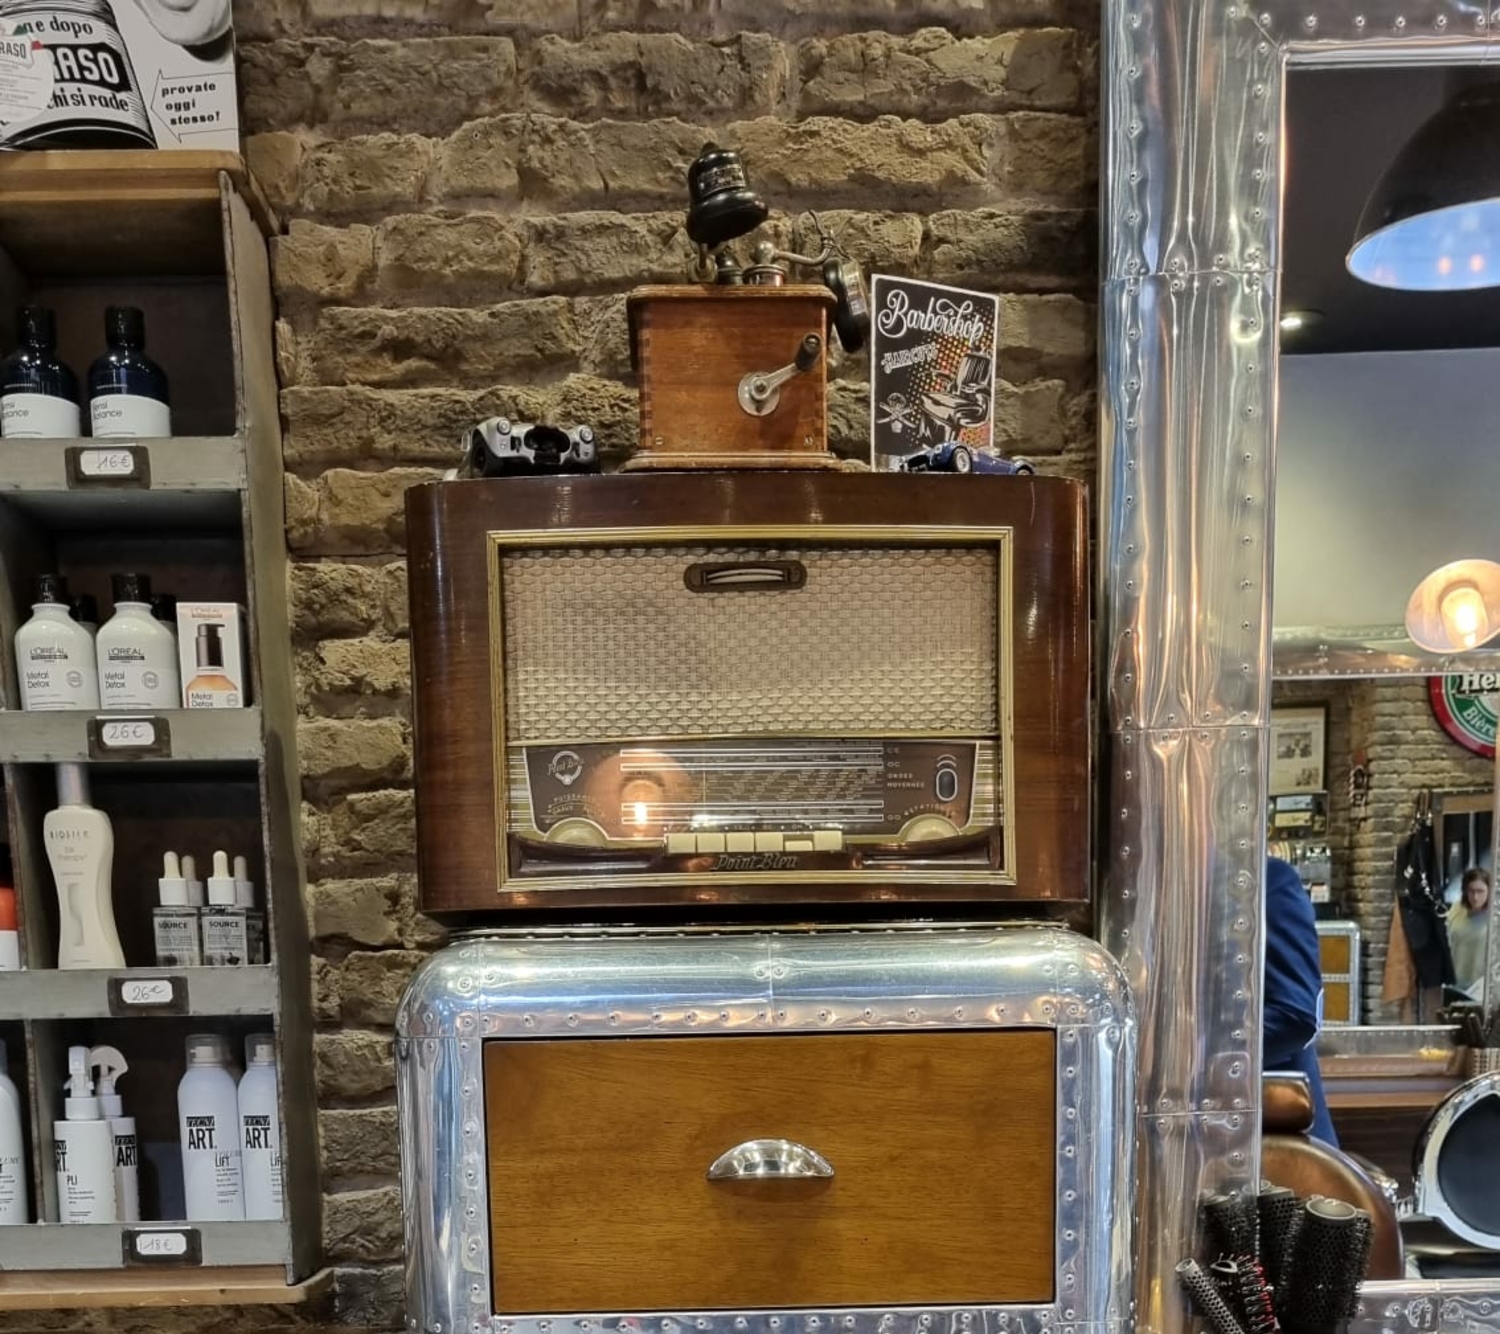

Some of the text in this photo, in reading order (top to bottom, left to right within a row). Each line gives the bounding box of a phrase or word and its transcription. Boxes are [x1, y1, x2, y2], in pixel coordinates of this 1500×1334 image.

[50, 15, 94, 39] dopo
[161, 81, 217, 98] provate
[88, 93, 130, 112] rade
[165, 98, 196, 112] oggi
[170, 110, 220, 126] stesso!
[877, 288, 984, 346] Barbershop
